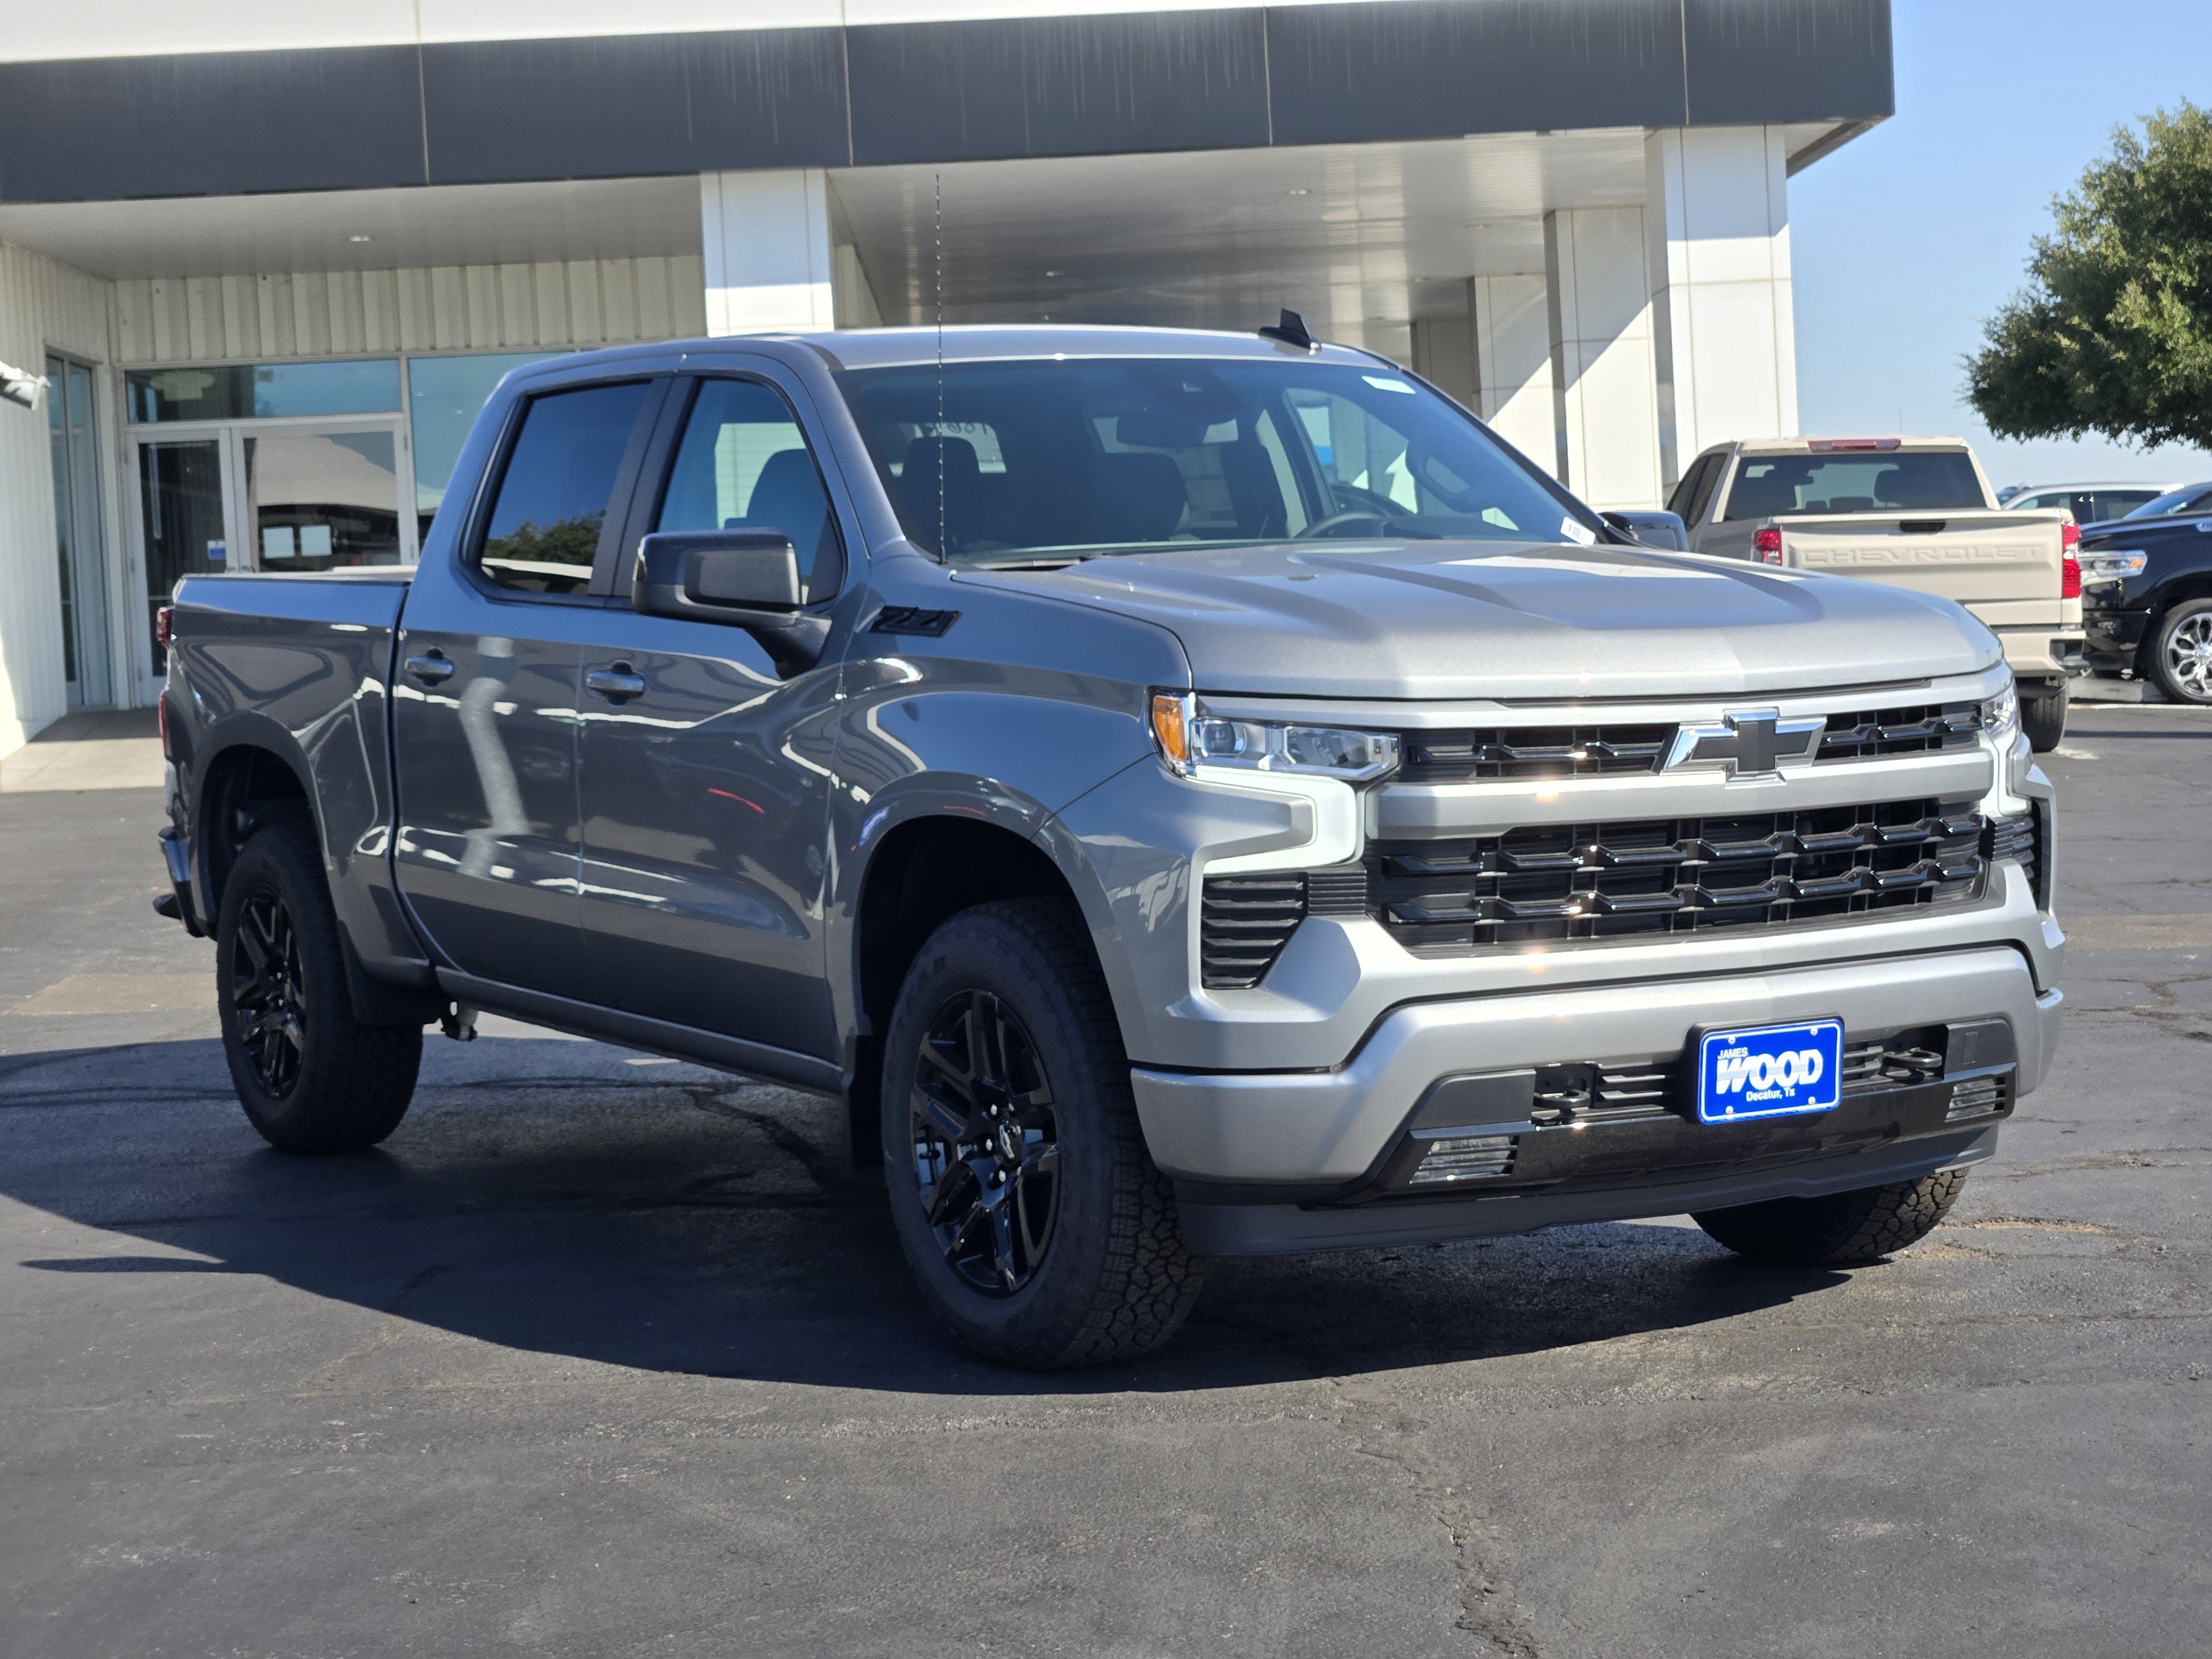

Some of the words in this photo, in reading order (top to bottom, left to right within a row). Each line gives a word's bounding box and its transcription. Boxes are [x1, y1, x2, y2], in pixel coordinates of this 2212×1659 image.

[1801, 545, 2043, 565] CHEVROLET
[1717, 1047, 1749, 1060] JAMES
[1716, 1049, 1824, 1094] WOOD
[1746, 1089, 1783, 1102] Decatur,
[1783, 1087, 1796, 1098] Tx
